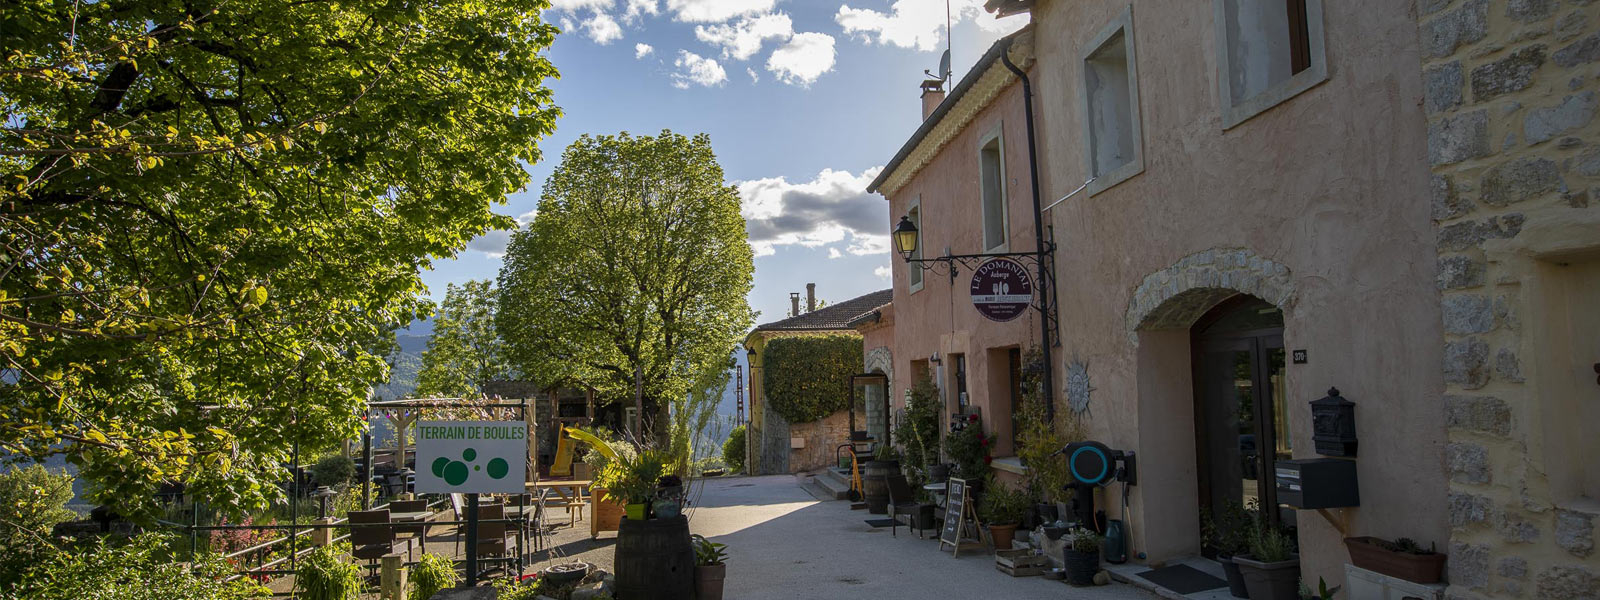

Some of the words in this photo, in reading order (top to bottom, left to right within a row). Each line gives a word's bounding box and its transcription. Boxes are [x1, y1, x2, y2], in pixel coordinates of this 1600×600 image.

[972, 275, 982, 290] LE
[979, 261, 1029, 289] DOMANIAL
[990, 270, 1010, 279] Auberge
[1294, 352, 1304, 361] 370
[419, 426, 465, 440] TERRAIN
[468, 426, 481, 440] DE
[483, 426, 524, 440] BOULES
